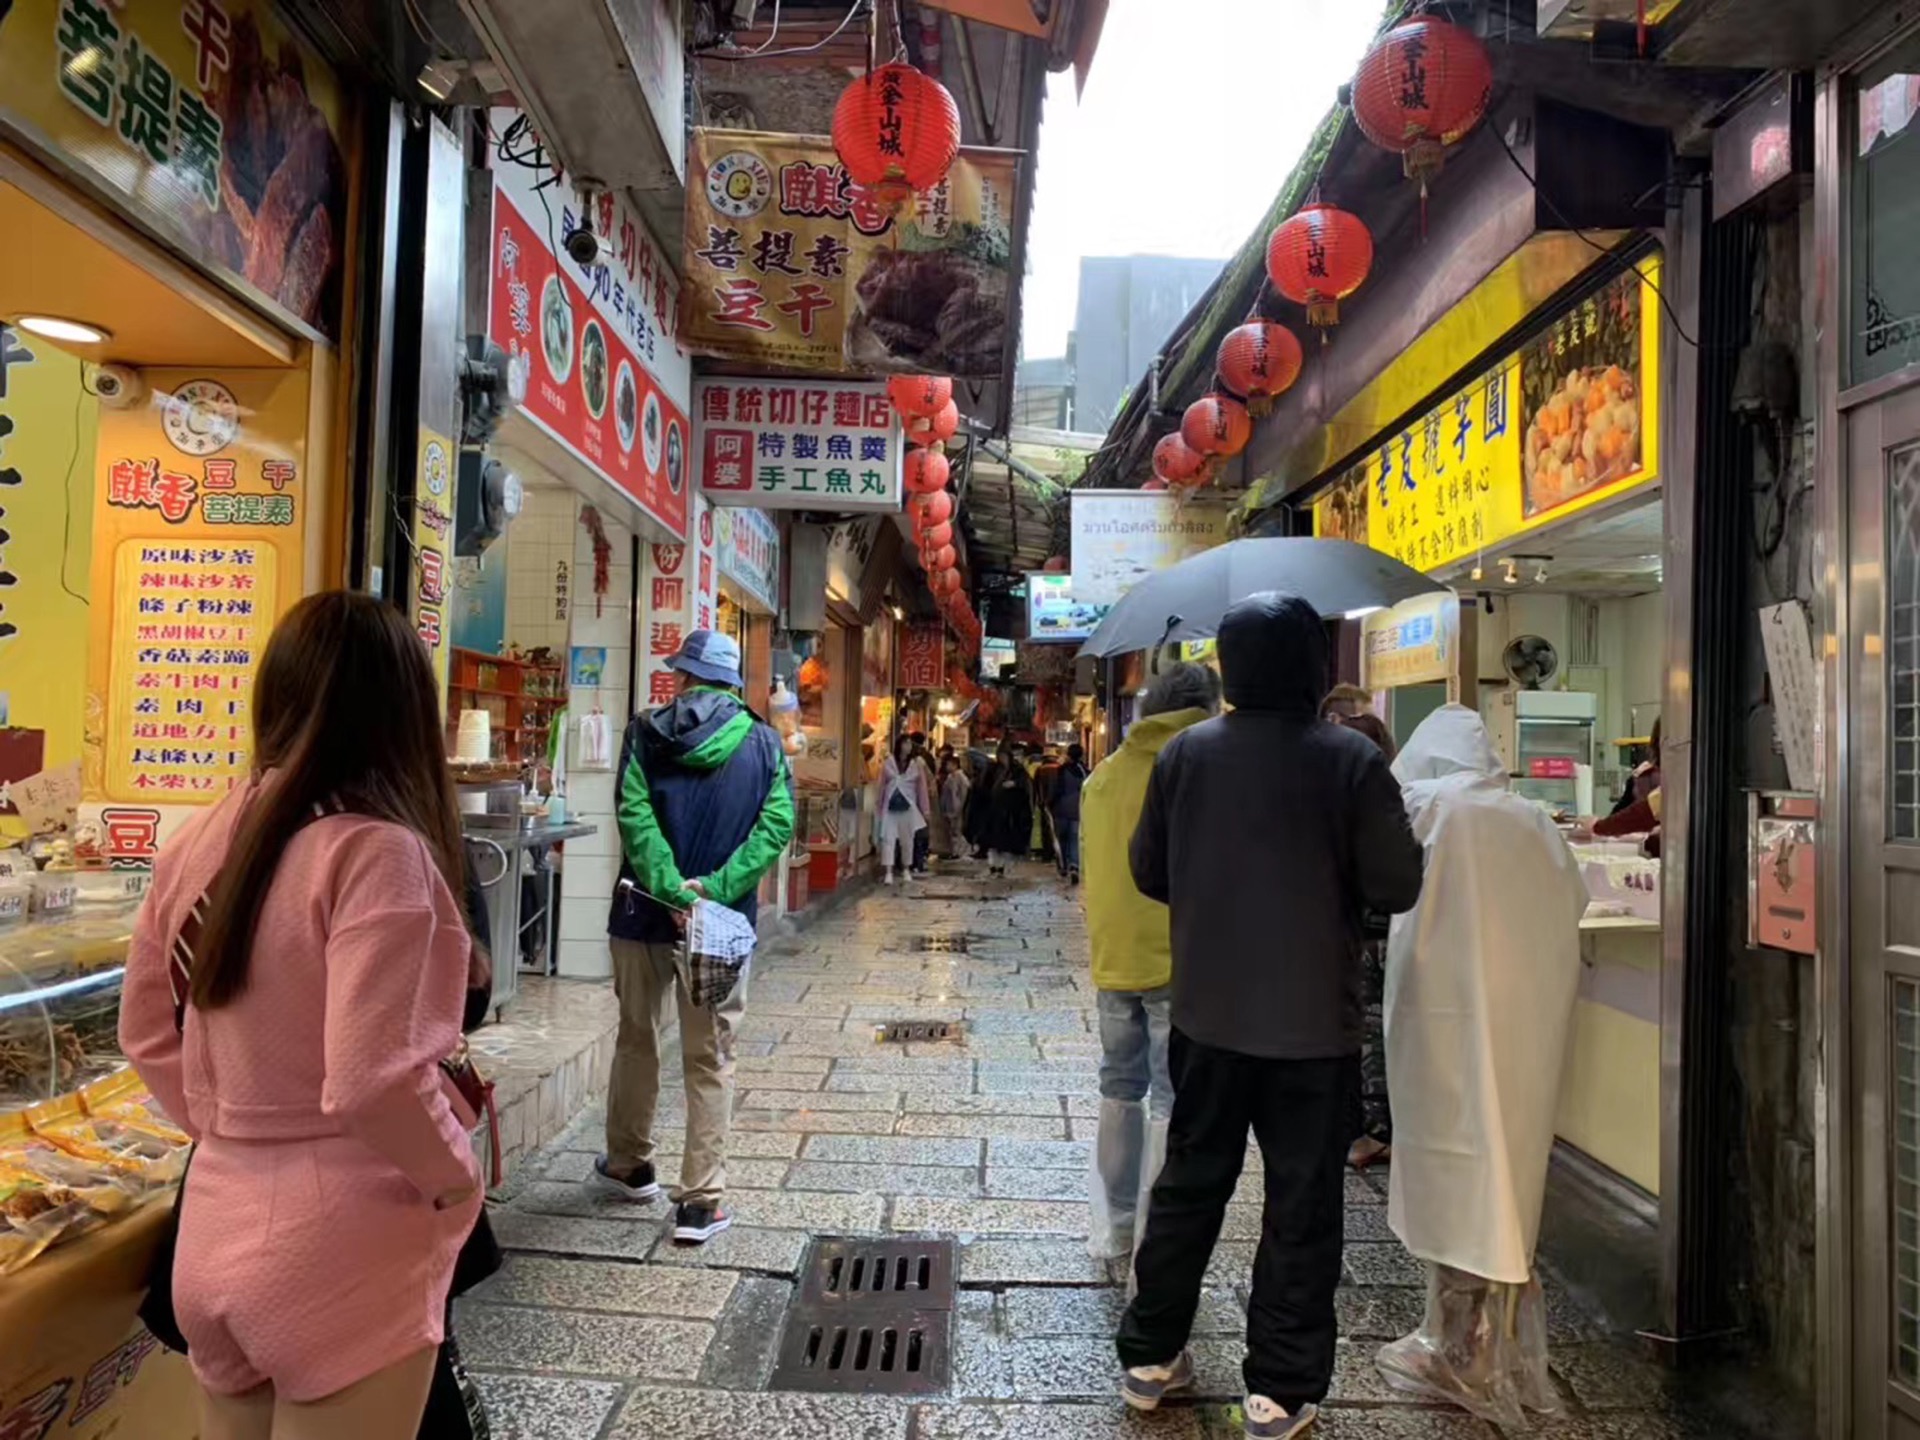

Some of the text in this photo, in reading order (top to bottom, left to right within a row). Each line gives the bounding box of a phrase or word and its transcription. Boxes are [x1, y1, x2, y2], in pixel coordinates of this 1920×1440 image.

[696, 224, 850, 278] 菩提素
[712, 278, 836, 336] 豆干
[702, 385, 891, 428] 傳統切仔麵店
[203, 458, 296, 490] 豆干
[714, 435, 743, 486] 阿婆
[757, 466, 887, 495] 手工魚丸
[202, 493, 295, 525] 菩提素
[102, 808, 160, 859] 豆
